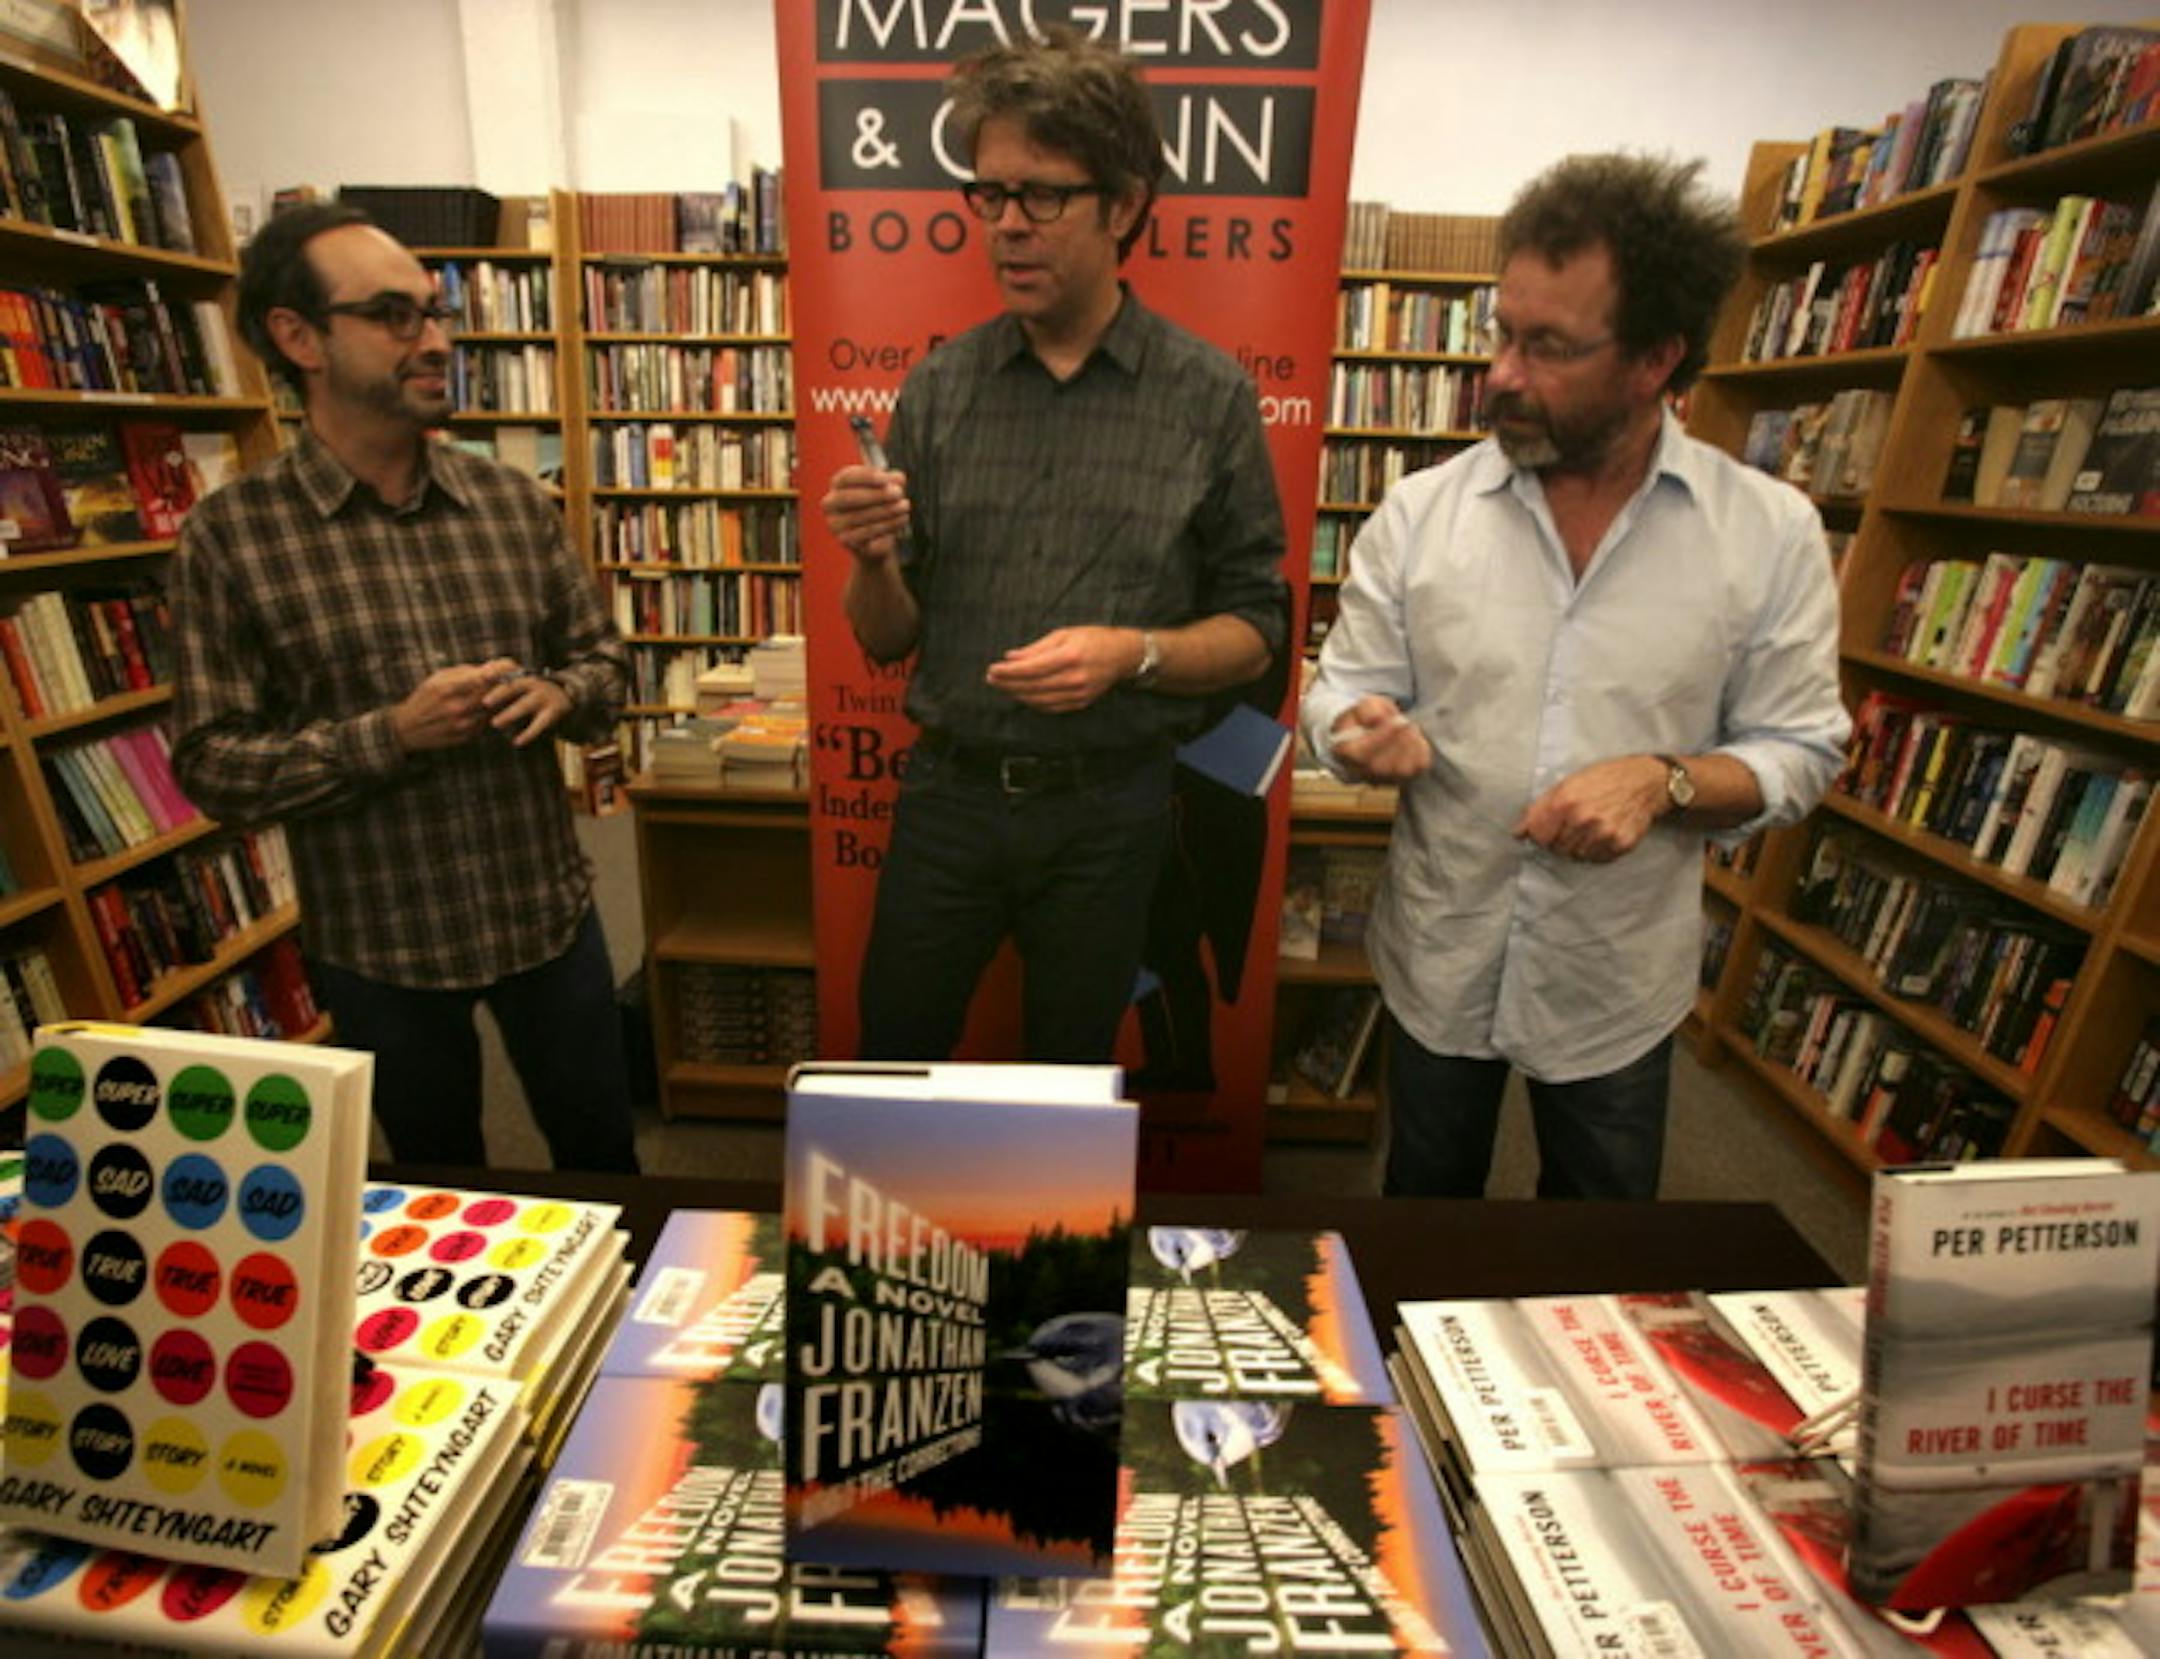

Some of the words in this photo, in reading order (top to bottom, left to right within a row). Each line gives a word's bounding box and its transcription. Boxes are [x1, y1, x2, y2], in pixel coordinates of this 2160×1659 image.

[834, 0, 1291, 57] MAGERS
[851, 108, 899, 168] &
[828, 211, 1293, 260] BOOLERS
[829, 338, 912, 371] Over
[97, 1078, 160, 1105] SUPER
[27, 1156, 76, 1186] SAD
[96, 1167, 150, 1197] SAD
[171, 1177, 225, 1207] SAD
[246, 1189, 298, 1219] SAD
[805, 1151, 990, 1302] FREEDOM
[1933, 1227, 1985, 1258] PER
[1997, 1220, 2140, 1254] PETTERSON
[86, 1251, 144, 1284] TRUE
[163, 1264, 219, 1294] TRUE
[238, 1276, 294, 1306] TRUE
[808, 1267, 855, 1298] A
[876, 1280, 986, 1324] NOVEL
[81, 1341, 137, 1371] LOVE
[158, 1354, 211, 1383] LOVE
[483, 1305, 529, 1362] GARY
[801, 1303, 988, 1377] JONATHAN
[1438, 1313, 1509, 1407] PETTERSON
[1597, 1330, 1634, 1367] TIME
[1752, 1303, 1841, 1394] PETTERSON
[1986, 1386, 1997, 1413] I
[2007, 1381, 2082, 1413] CURSE
[2094, 1377, 2138, 1406] THE
[75, 1427, 131, 1453] STORY
[147, 1442, 207, 1468] STORY
[802, 1370, 984, 1484] FRANZEN
[1491, 1413, 1526, 1452] PER
[1645, 1396, 1695, 1453] RIVER
[1907, 1425, 1980, 1455] RIVER
[1992, 1423, 2024, 1453] OF
[2034, 1418, 2089, 1448] TIME
[1, 1475, 76, 1516] GARY
[78, 1495, 278, 1553] SHTEYNGART
[324, 1545, 388, 1640] GARY
[385, 1388, 499, 1545] SHTEYNGART
[1655, 1477, 1694, 1514] THE
[550, 1465, 738, 1610] FREEDOM
[670, 1571, 708, 1612] A
[695, 1471, 756, 1556] NOVEL
[1171, 1496, 1200, 1584] NOVEL
[1521, 1489, 1608, 1621] PETTERSON
[1684, 1522, 1748, 1593] CURSE
[1714, 1513, 1762, 1564] TIME
[1200, 1494, 1283, 1653] JONATHAN
[1241, 1496, 1401, 1652] FRANZEN
[1754, 1575, 1791, 1601] OF
[1162, 1599, 1198, 1645] A
